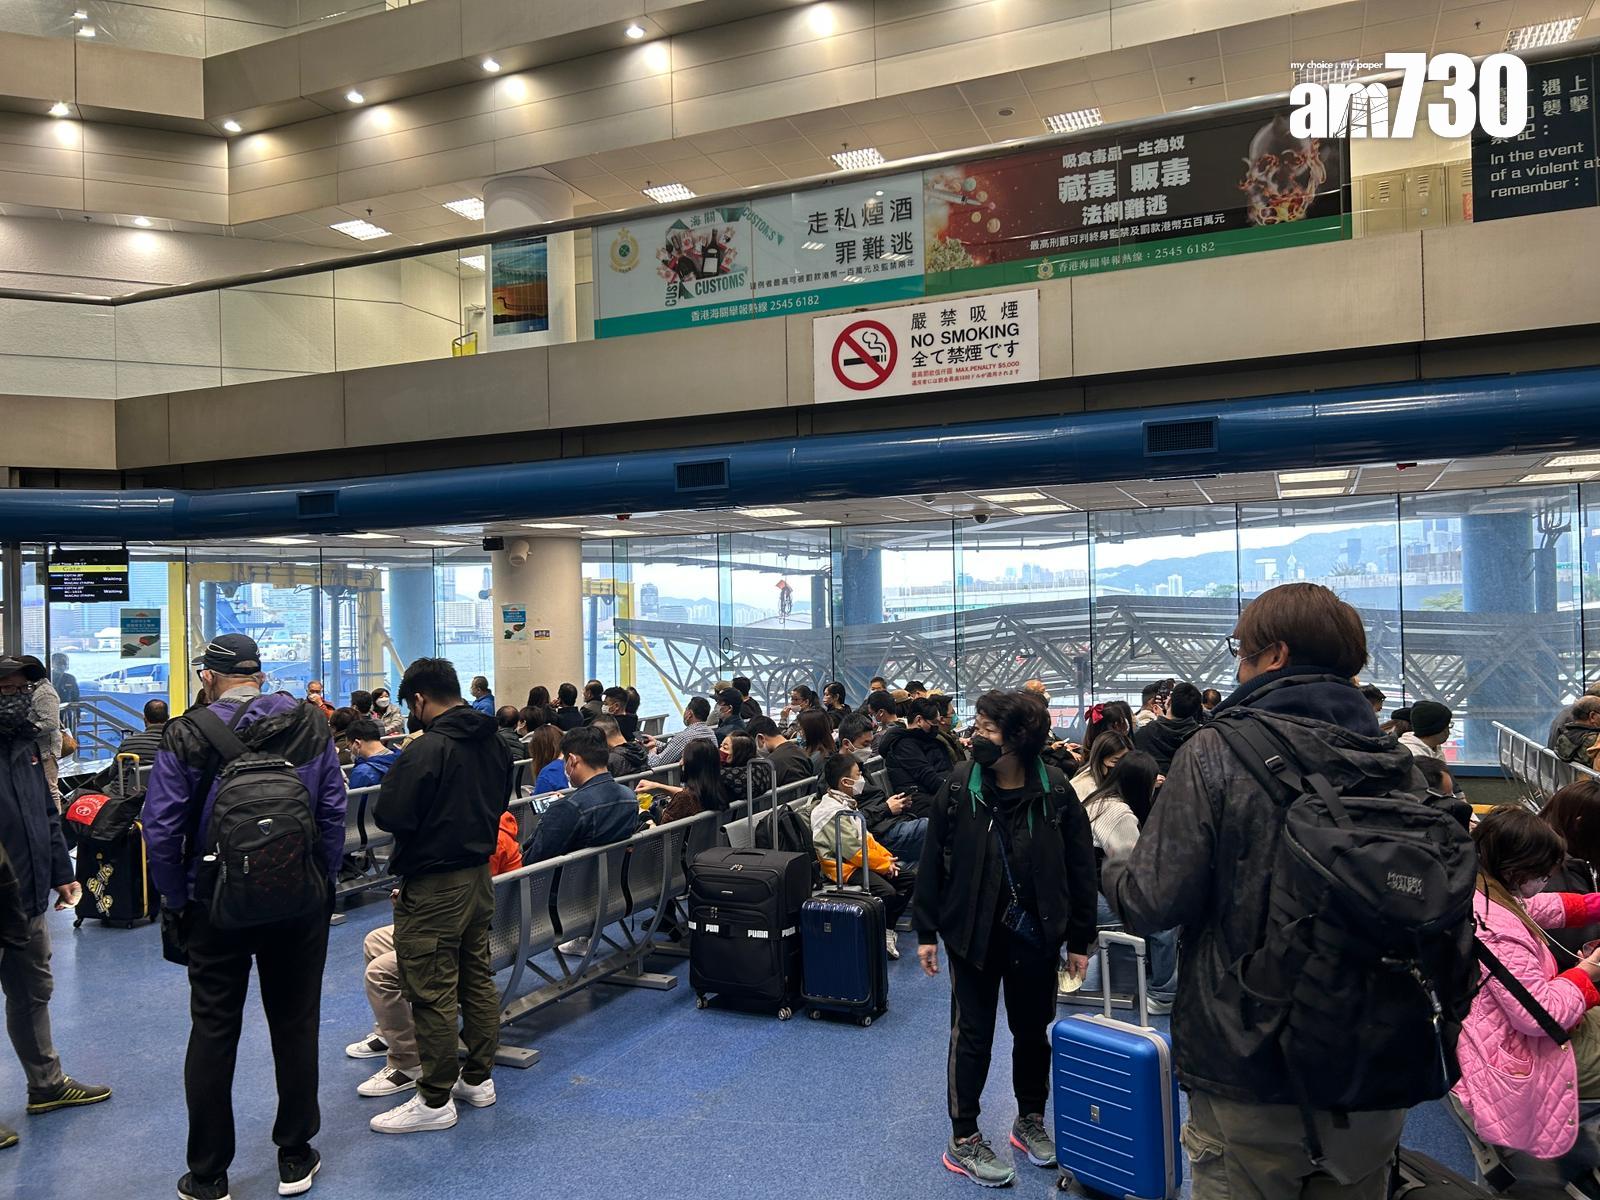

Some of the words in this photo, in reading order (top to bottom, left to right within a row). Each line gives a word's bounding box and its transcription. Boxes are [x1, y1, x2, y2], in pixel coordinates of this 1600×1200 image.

[1062, 135, 1185, 169] 吸食毒品一生為奴
[1490, 154, 1504, 165] In
[1508, 150, 1535, 162] the
[1538, 142, 1584, 158] event
[1057, 169, 1116, 204] 藏毒
[1130, 156, 1191, 193] 販毒
[1490, 168, 1507, 181] of
[1511, 169, 1521, 178] a
[1526, 159, 1579, 176] violent
[1491, 179, 1570, 198] remember
[807, 196, 912, 236] 走私煙酒
[1081, 193, 1168, 227] 法網難逃
[742, 207, 777, 241] CUSTOMS
[835, 231, 914, 265] 罪難逃
[1154, 246, 1183, 259] 2545
[1186, 241, 1216, 255] 6182
[694, 274, 745, 296] CUSTOMS
[770, 300, 793, 311] 2545
[795, 295, 820, 307] 6182
[911, 300, 1019, 331] 嚴禁吸煙
[911, 333, 935, 348] NO
[941, 322, 1020, 345] SMOKING
[911, 340, 1019, 368] 全て禁煙です
[1387, 872, 1423, 887] MYSTERY
[747, 929, 769, 939] PUMA
